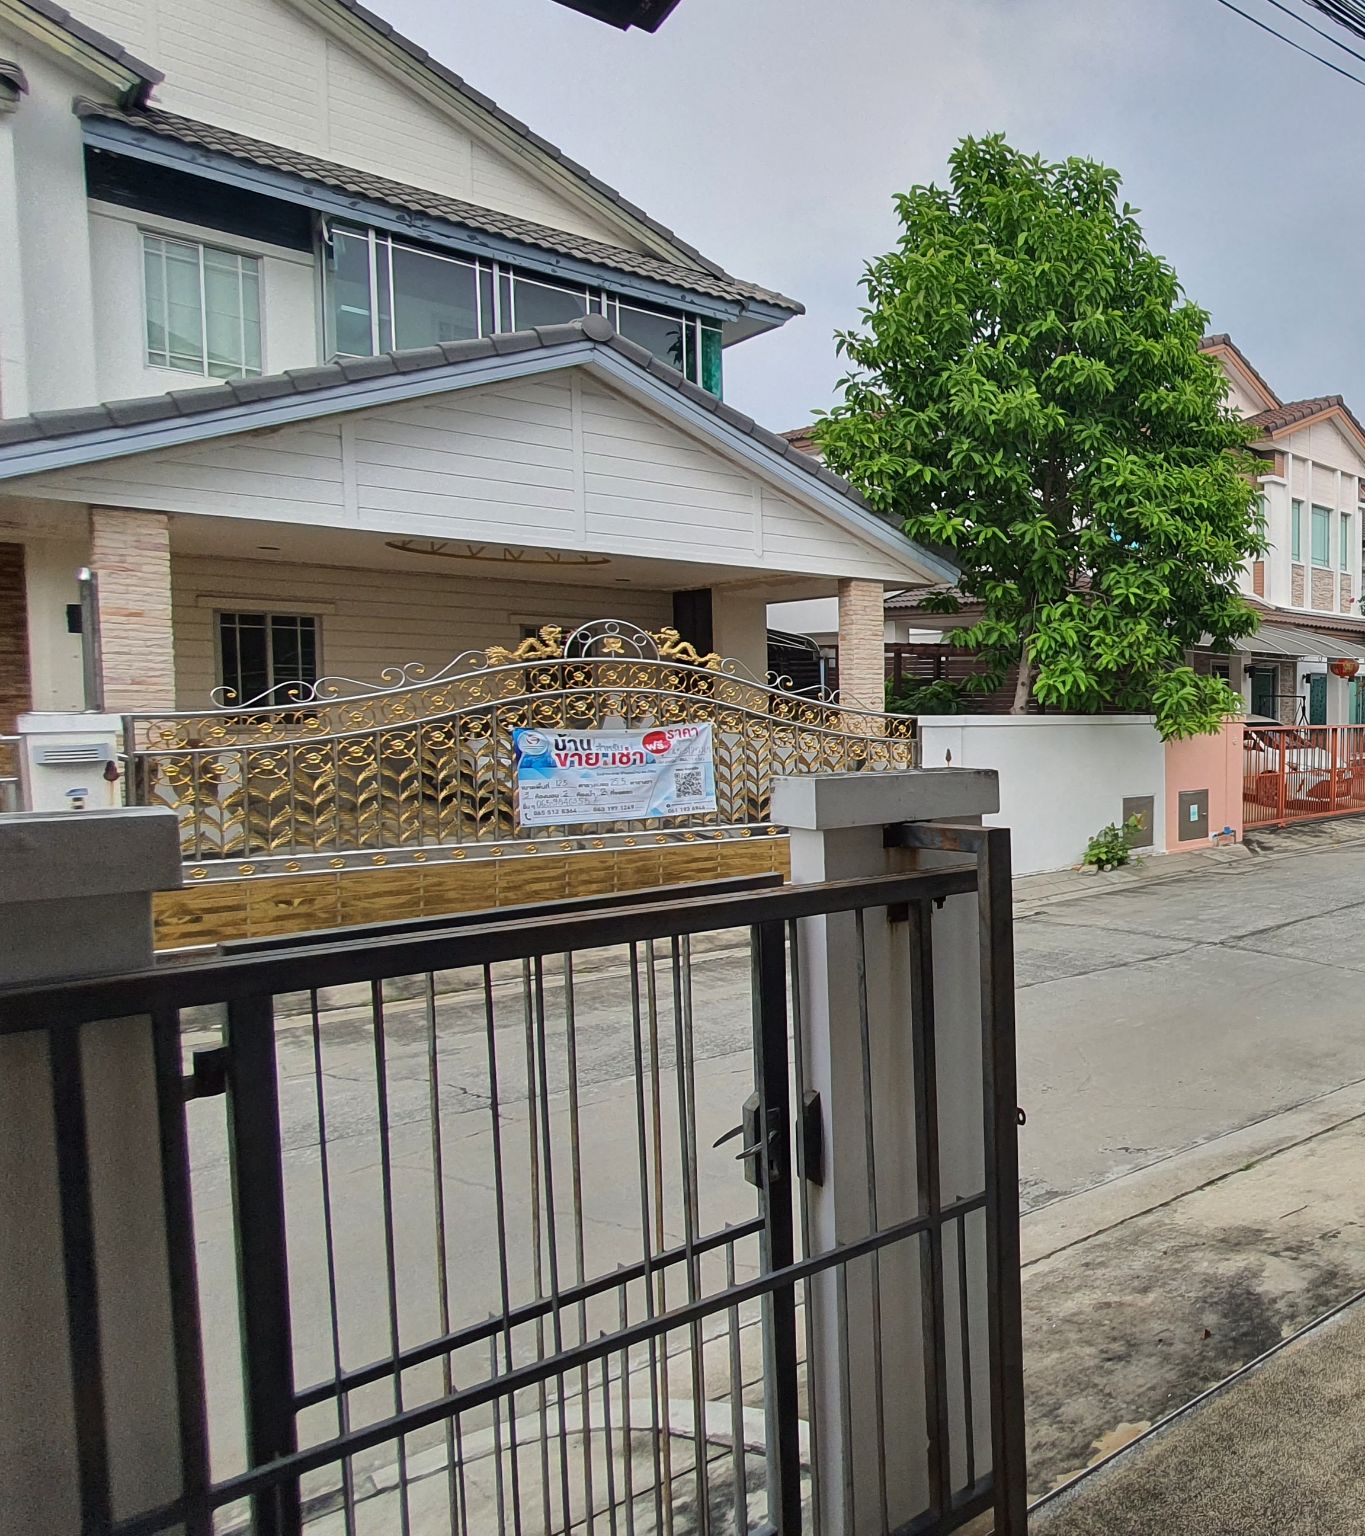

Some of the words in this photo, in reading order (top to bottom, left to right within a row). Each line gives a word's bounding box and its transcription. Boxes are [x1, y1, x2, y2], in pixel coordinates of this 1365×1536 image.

[667, 727, 699, 739] ราคา
[554, 734, 592, 751] บ้าน
[555, 752, 600, 767] ขาย
[611, 745, 644, 766] เช่า
